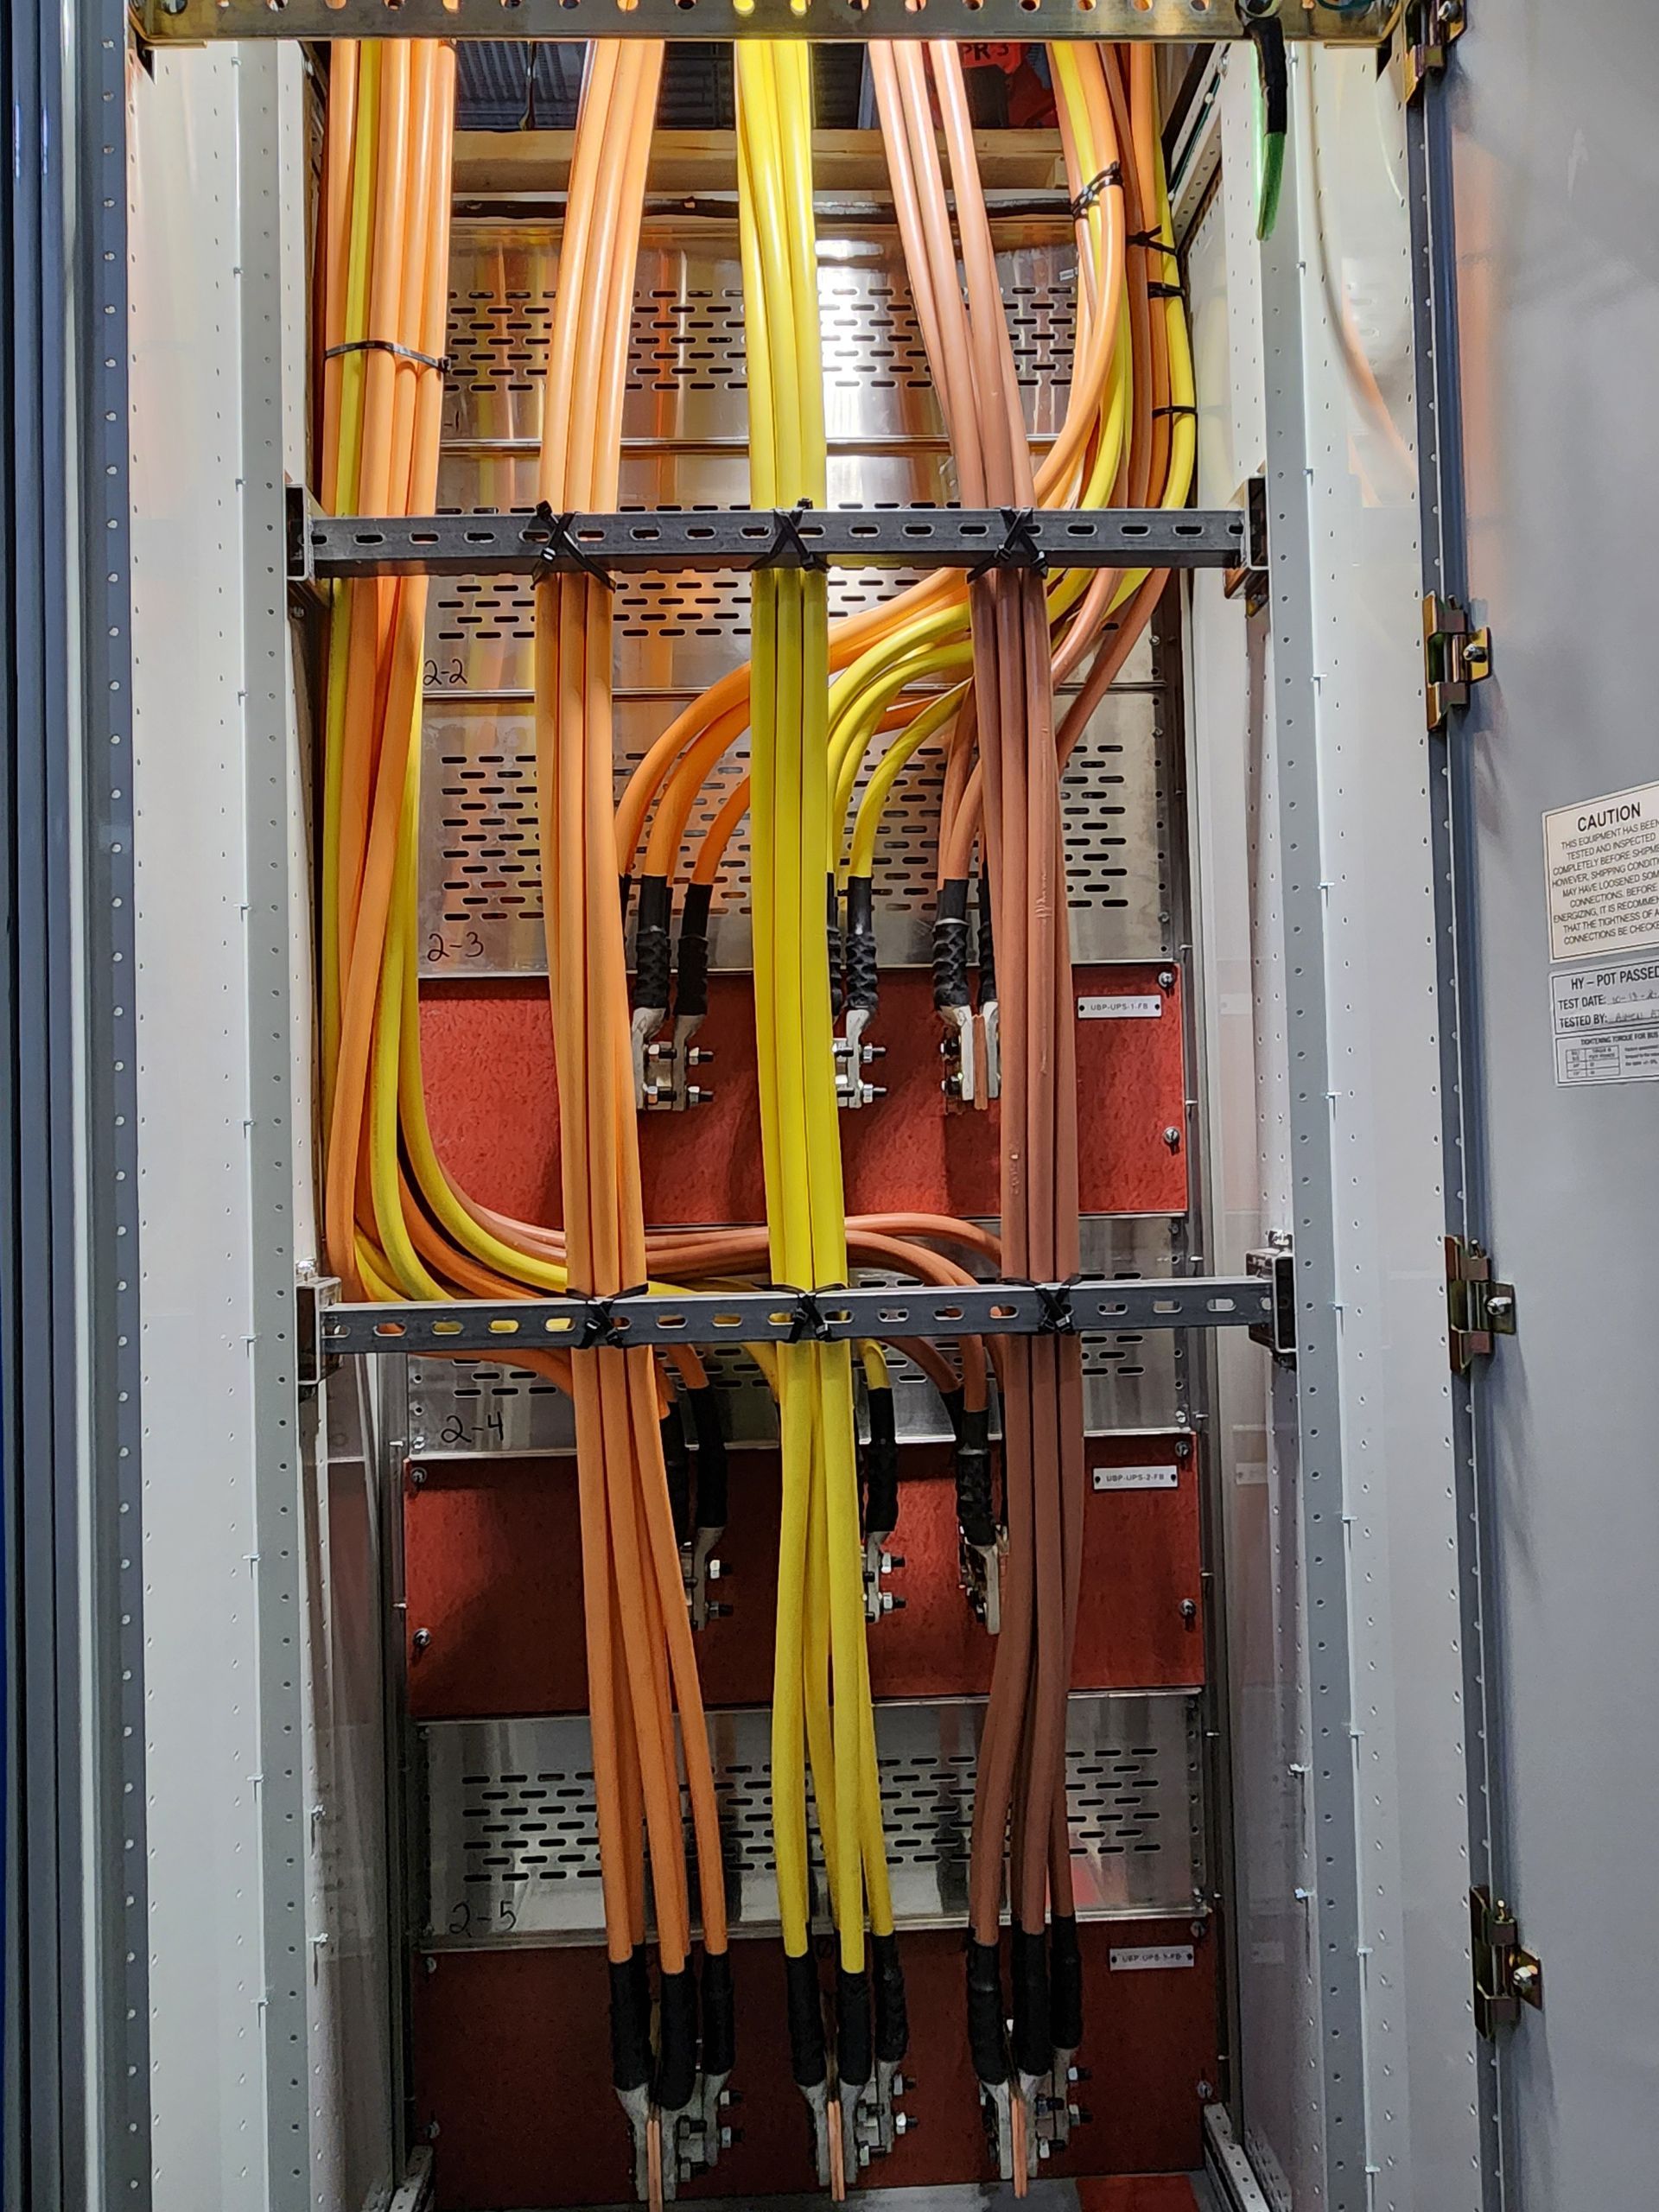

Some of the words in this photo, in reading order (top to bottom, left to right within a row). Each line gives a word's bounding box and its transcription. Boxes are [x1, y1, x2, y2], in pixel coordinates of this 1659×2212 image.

[423, 658, 467, 685] 2-2
[1578, 802, 1641, 831] CAUTION
[1561, 839, 1578, 849] THIS
[1579, 828, 1622, 846] EQUIPMENT
[1623, 823, 1638, 836] HAS
[1567, 847, 1594, 861] TESTED
[1596, 843, 1611, 854] AND
[1613, 832, 1656, 849] INSPECTED
[1553, 858, 1599, 875] COMPLETELY
[1600, 850, 1630, 865] BEFORE
[1591, 865, 1625, 880] SHIPPING
[1563, 887, 1577, 898] MAY
[1579, 882, 1598, 894] HAVE
[1599, 874, 1640, 890] LOOSENED
[1626, 882, 1657, 897] BEFORE
[1563, 923, 1581, 933] THAT
[1582, 919, 1597, 930] THE
[1599, 912, 1640, 927] TIGHTNESS
[1642, 908, 1652, 918] OF
[1600, 906, 1606, 914] IT
[1608, 904, 1615, 912] IS
[428, 932, 484, 962] 2-3
[1564, 928, 1616, 945] CONNECTIONS
[1618, 926, 1627, 936] BE
[1571, 977, 1584, 990] HY
[1597, 972, 1617, 987] POT
[1619, 965, 1659, 983] PASSED
[1558, 997, 1580, 1010] TEST
[1581, 994, 1606, 1007] DATE:
[1559, 1014, 1592, 1028] TESTED
[1593, 1013, 1607, 1025] BY:
[441, 1411, 504, 1443] 2-4
[449, 1900, 517, 1938] 2-5
